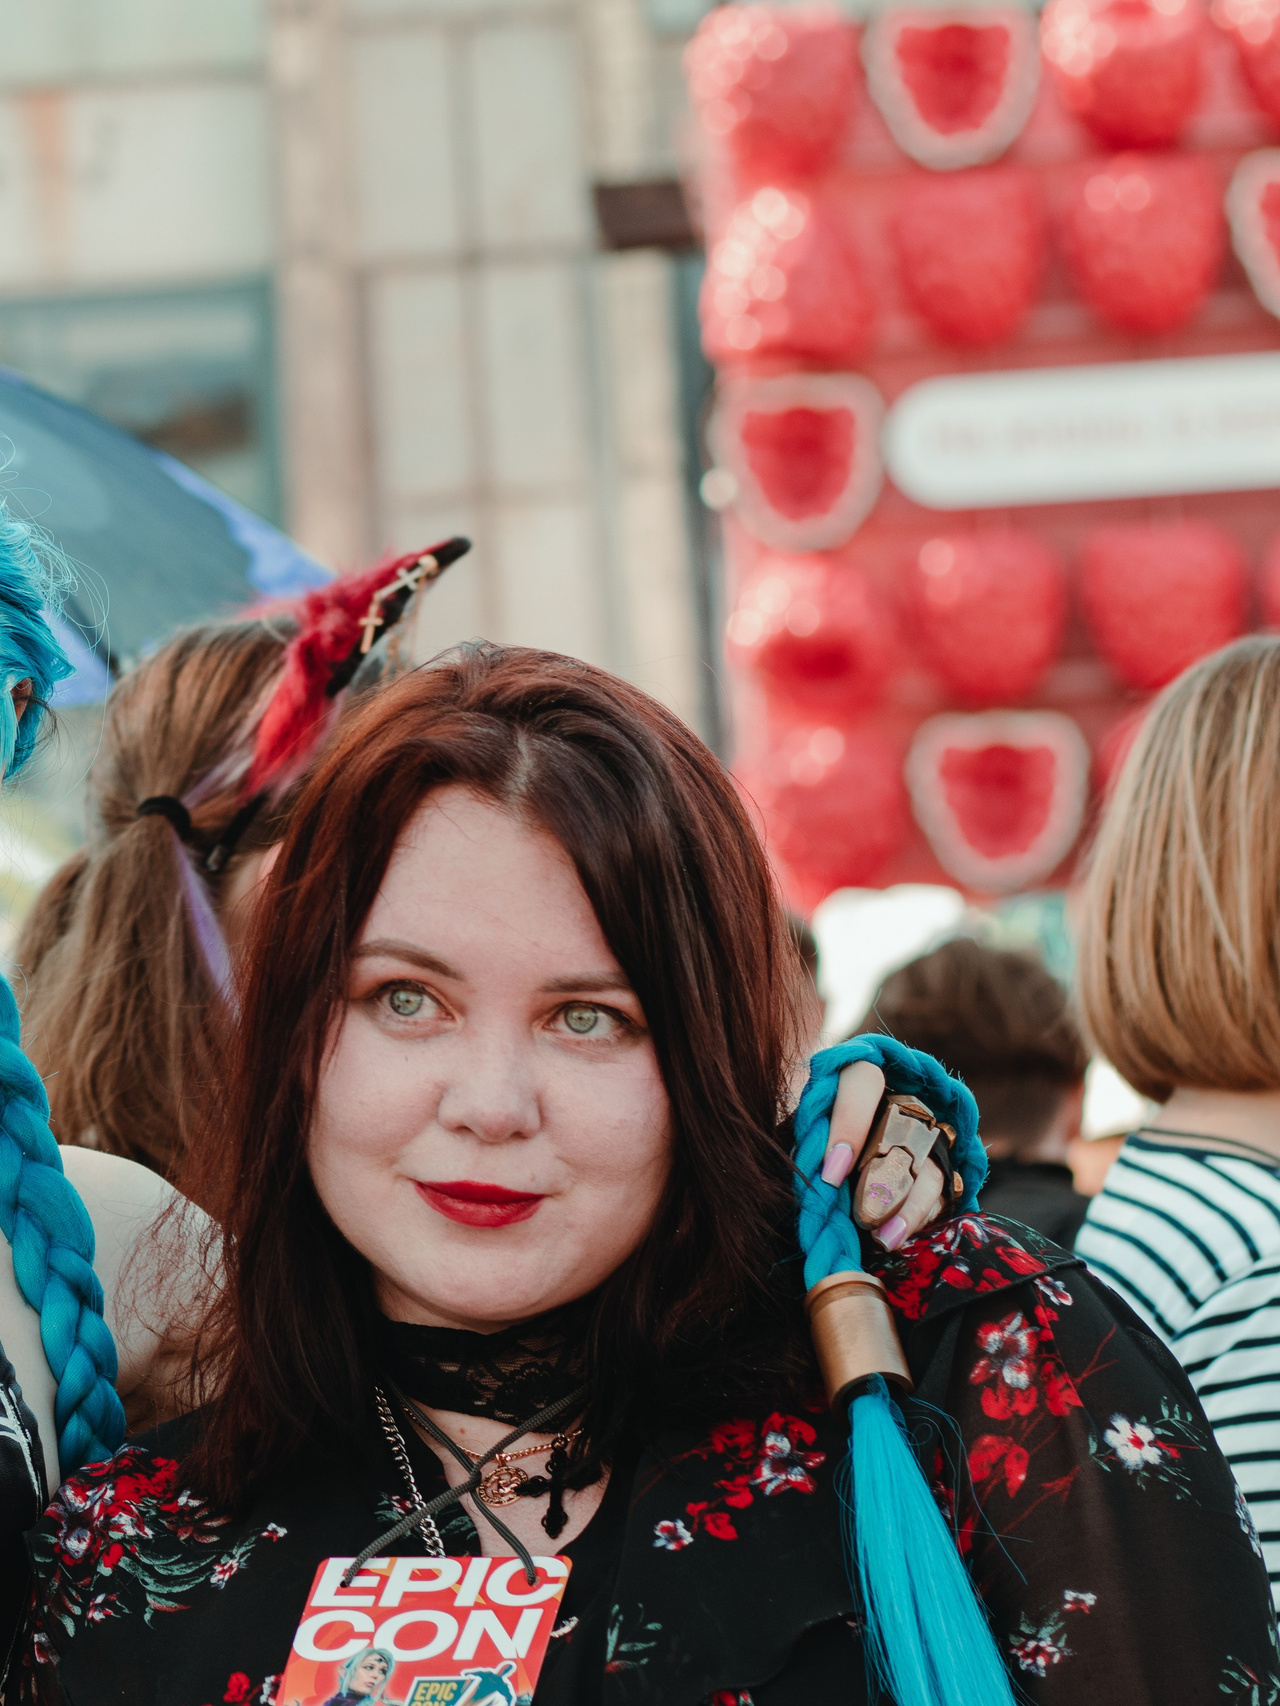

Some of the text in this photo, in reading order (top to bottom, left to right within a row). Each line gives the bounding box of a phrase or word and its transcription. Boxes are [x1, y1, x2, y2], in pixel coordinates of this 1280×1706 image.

[309, 1556, 569, 1607] EPIC
[292, 1608, 544, 1662] CON
[414, 1682, 458, 1701] EPIC
